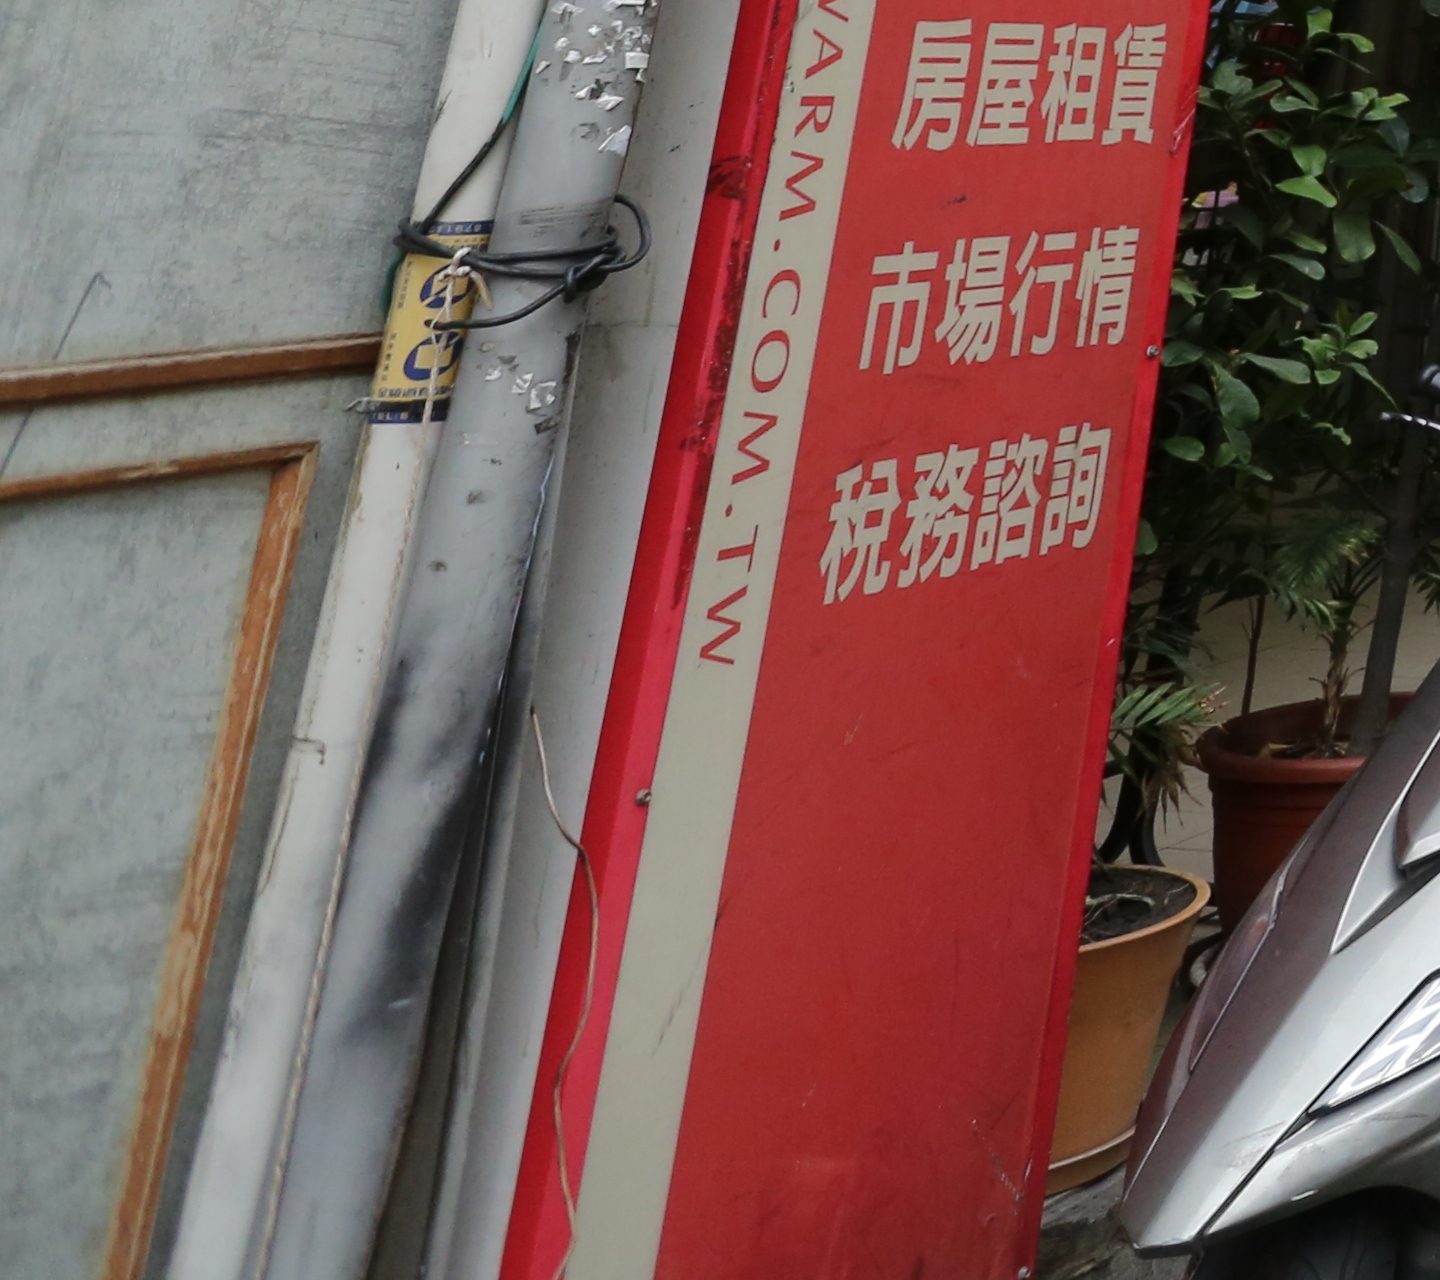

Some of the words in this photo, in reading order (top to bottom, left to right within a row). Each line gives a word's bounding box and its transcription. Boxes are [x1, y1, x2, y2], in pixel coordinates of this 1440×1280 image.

[892, 18, 1166, 154] 房屋租賃
[858, 225, 1139, 376] 市場行情
[819, 425, 1112, 606] 稅務諮詢
